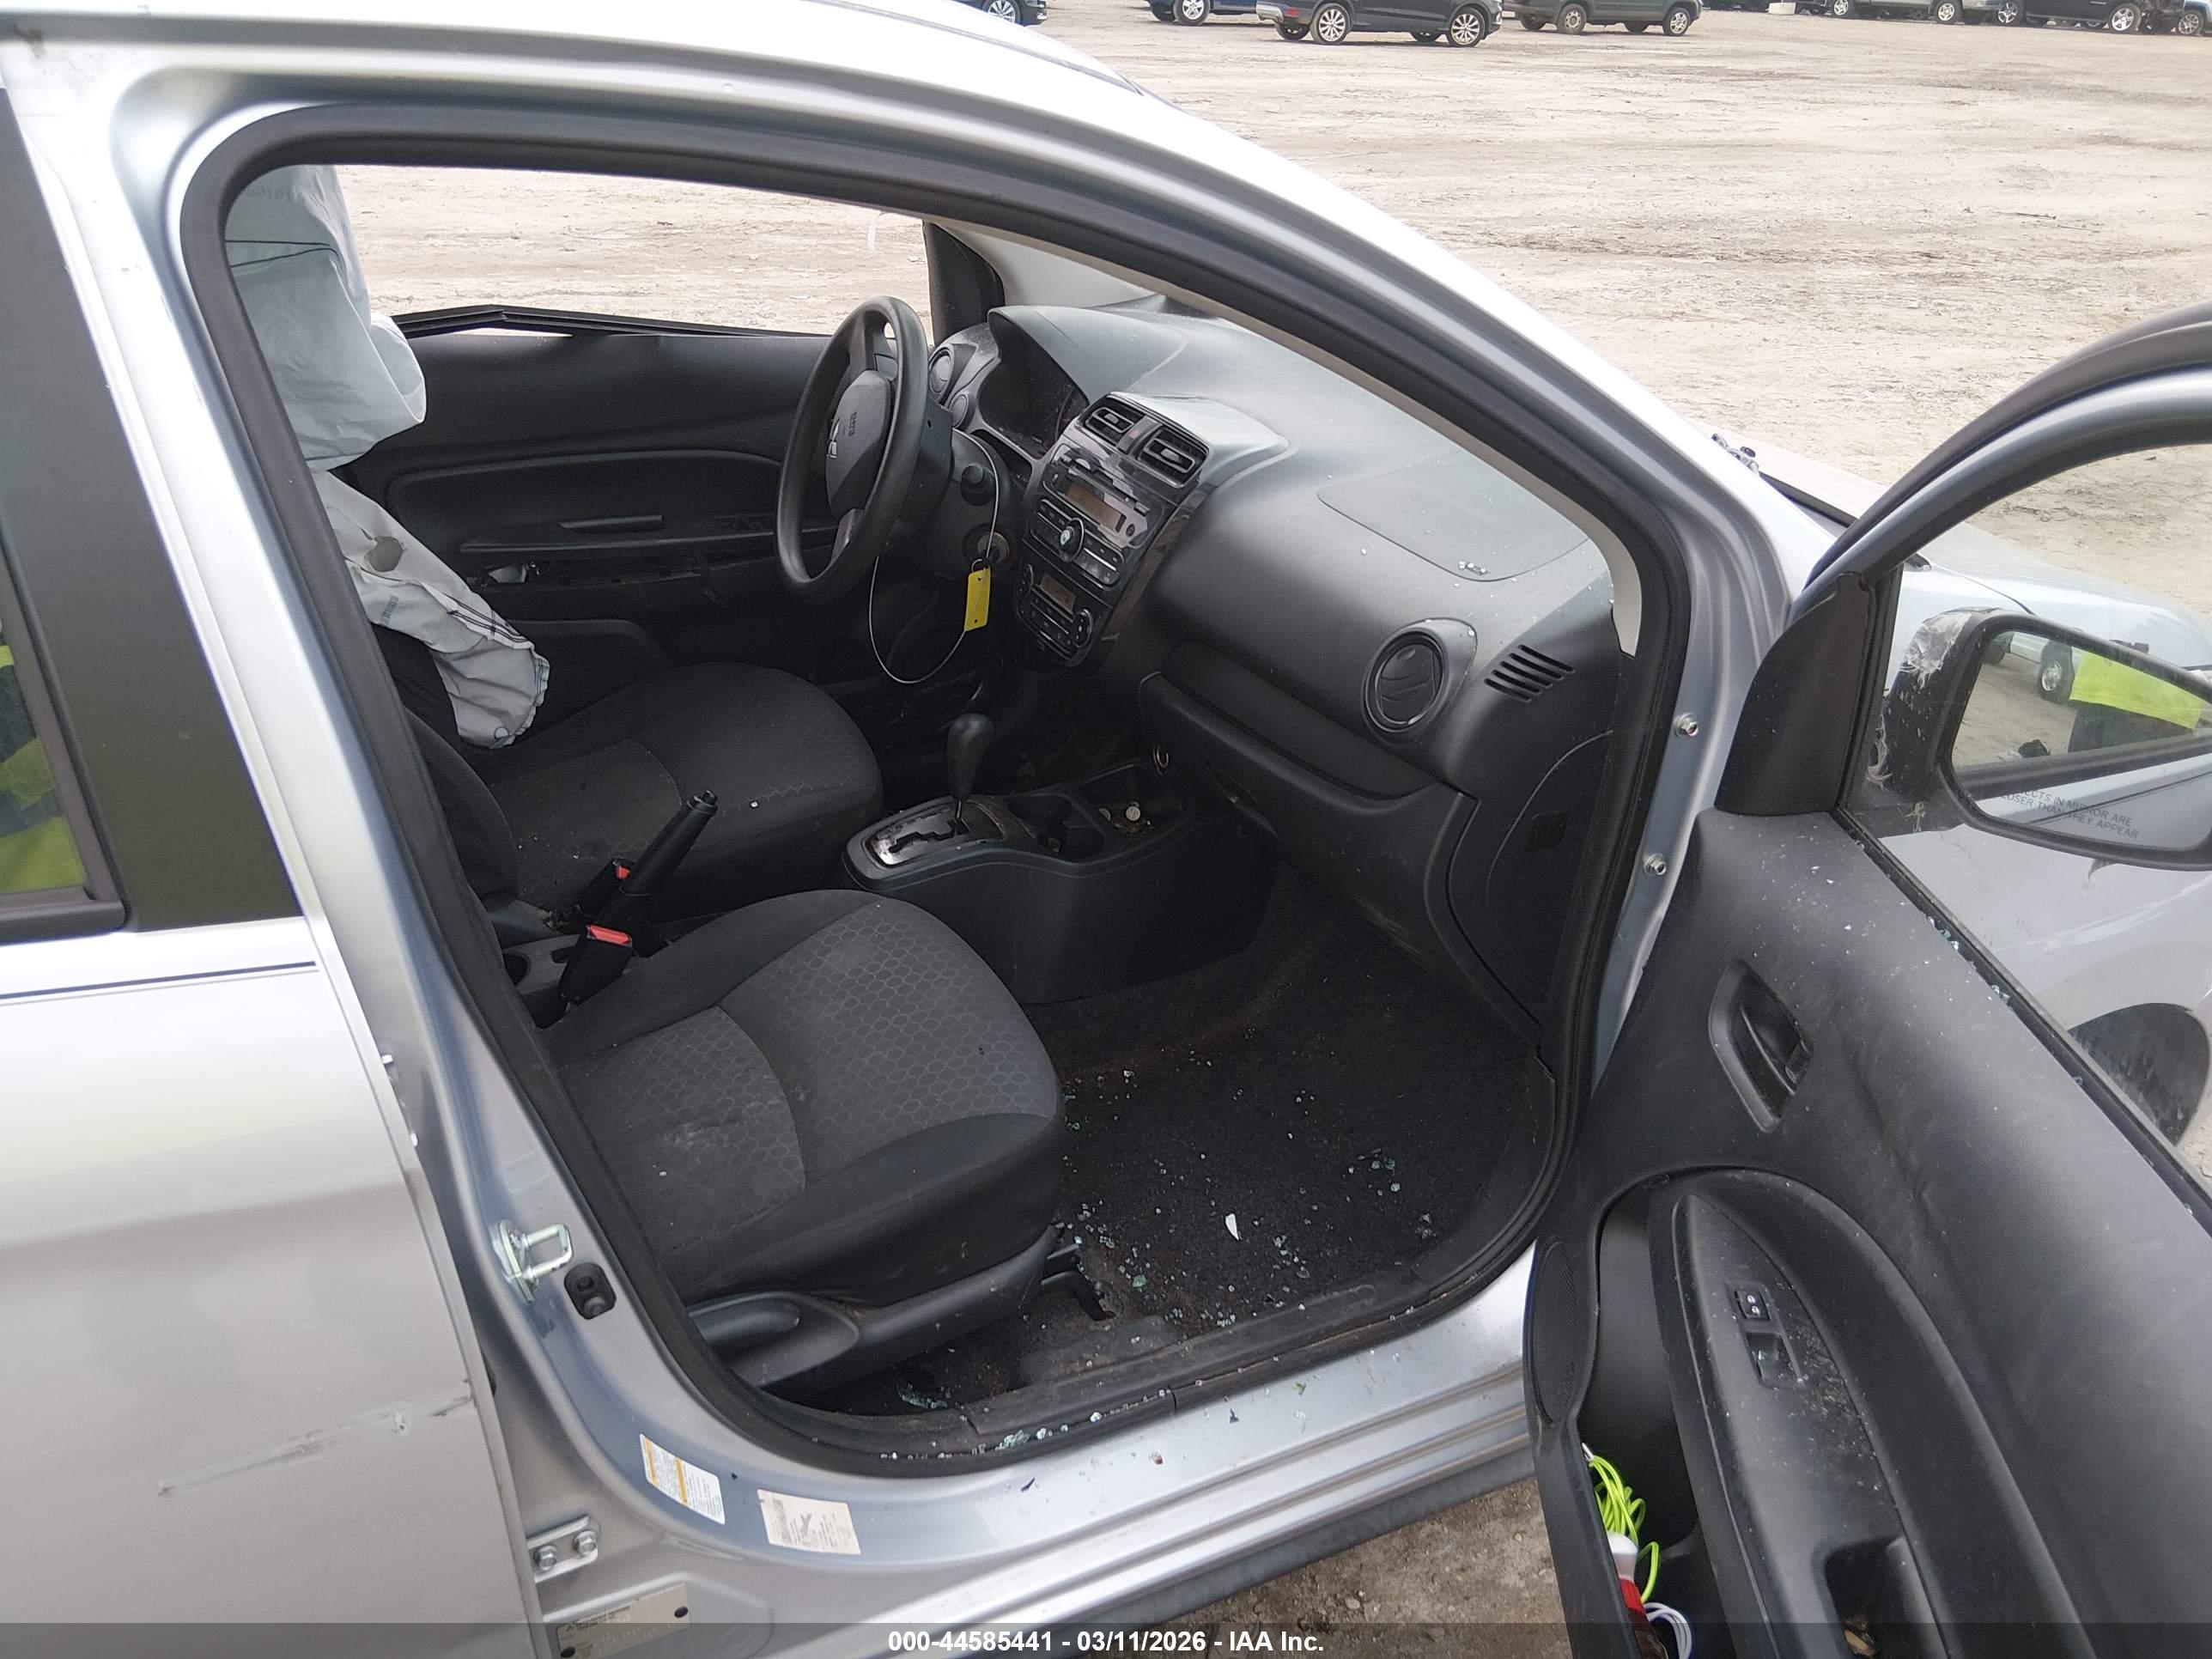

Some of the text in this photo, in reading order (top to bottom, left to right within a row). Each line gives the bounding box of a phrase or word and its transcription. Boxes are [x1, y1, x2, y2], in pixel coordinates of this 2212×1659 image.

[2038, 801, 2065, 815] THAN
[2095, 820, 2140, 839] APPEAR
[2053, 796, 2065, 806] IN
[2111, 813, 2134, 827] ARE
